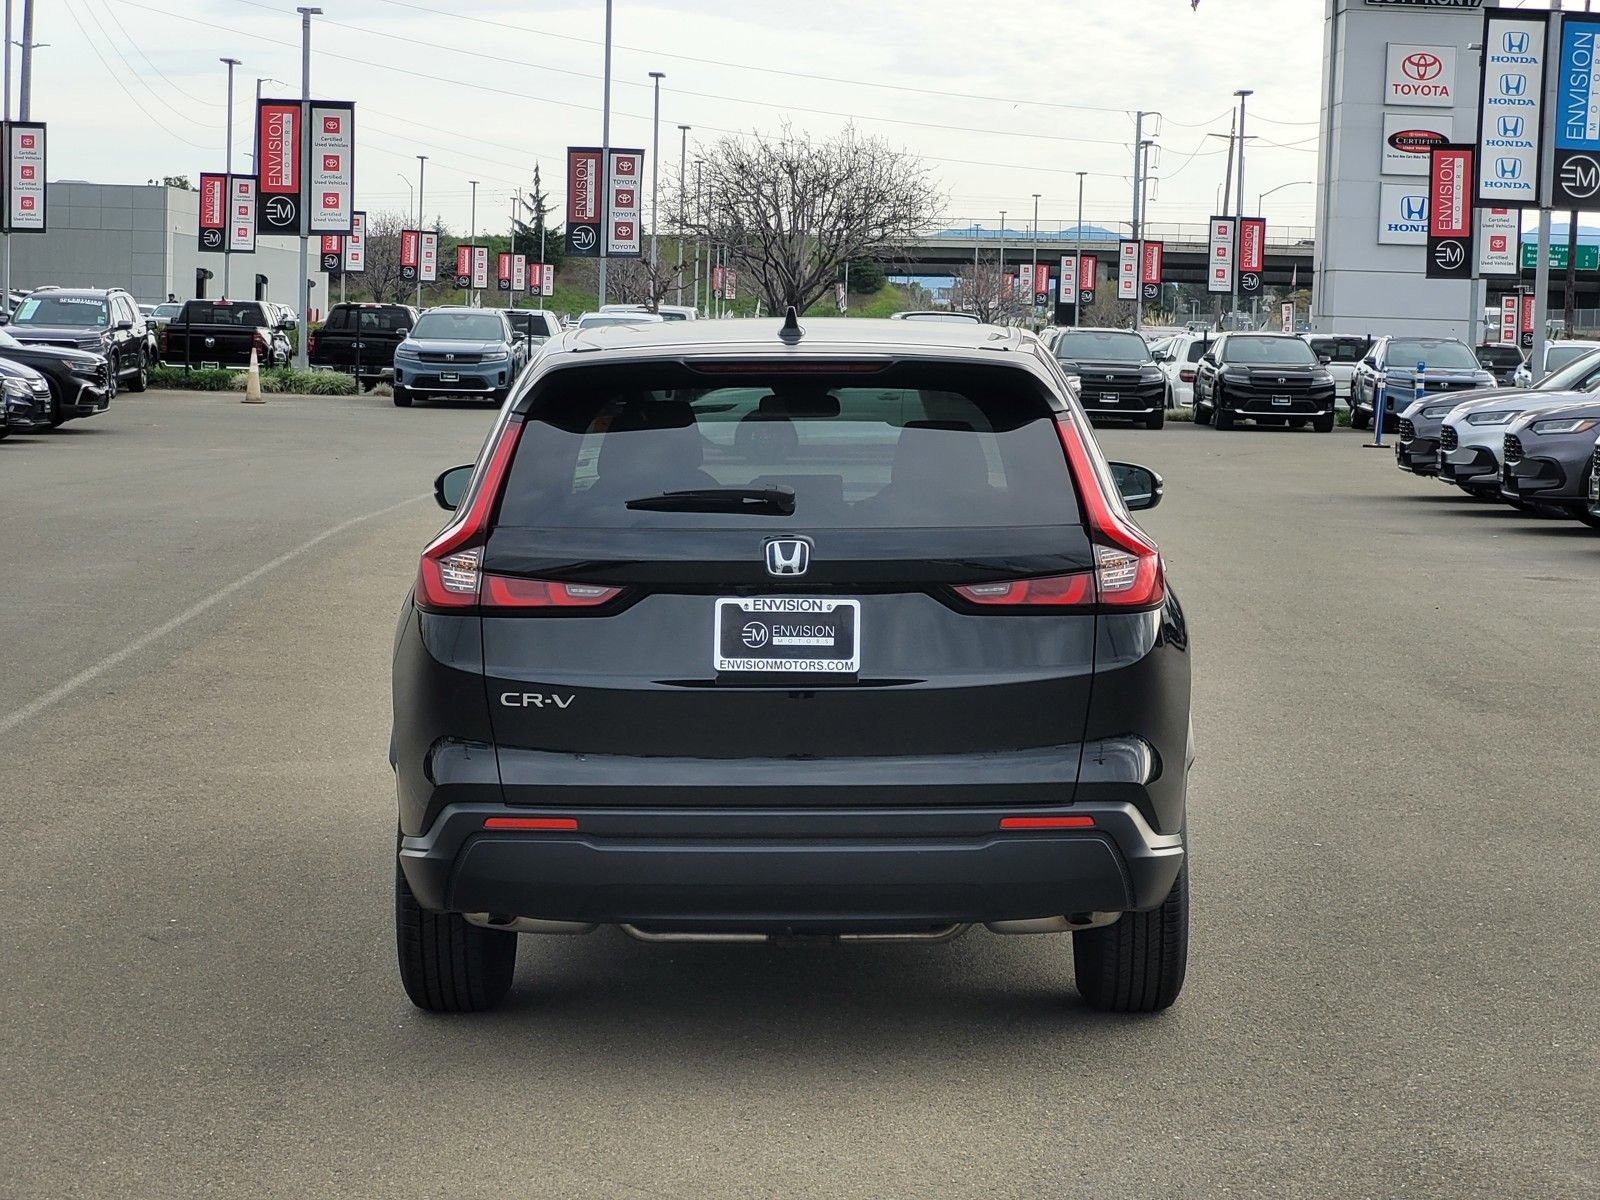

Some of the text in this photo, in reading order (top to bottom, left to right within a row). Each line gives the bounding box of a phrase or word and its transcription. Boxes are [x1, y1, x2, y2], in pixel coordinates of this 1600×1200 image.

[1490, 56, 1538, 64] HONDA
[1392, 84, 1449, 96] TOYOTA
[1567, 32, 1592, 140] ENVISION
[268, 112, 282, 186] ENVISION
[576, 158, 587, 217] ENVISION
[1484, 182, 1532, 190] HONDA
[1438, 157, 1453, 230] ENVISION
[206, 181, 214, 224] ENVISION
[1388, 224, 1428, 232] HOND
[1244, 225, 1254, 267] ENVISION
[753, 600, 823, 611] ENVISION
[772, 625, 835, 637] ENVISION
[720, 660, 854, 671] ENVISIONMOTORS.COM
[500, 692, 576, 708] CR-V
